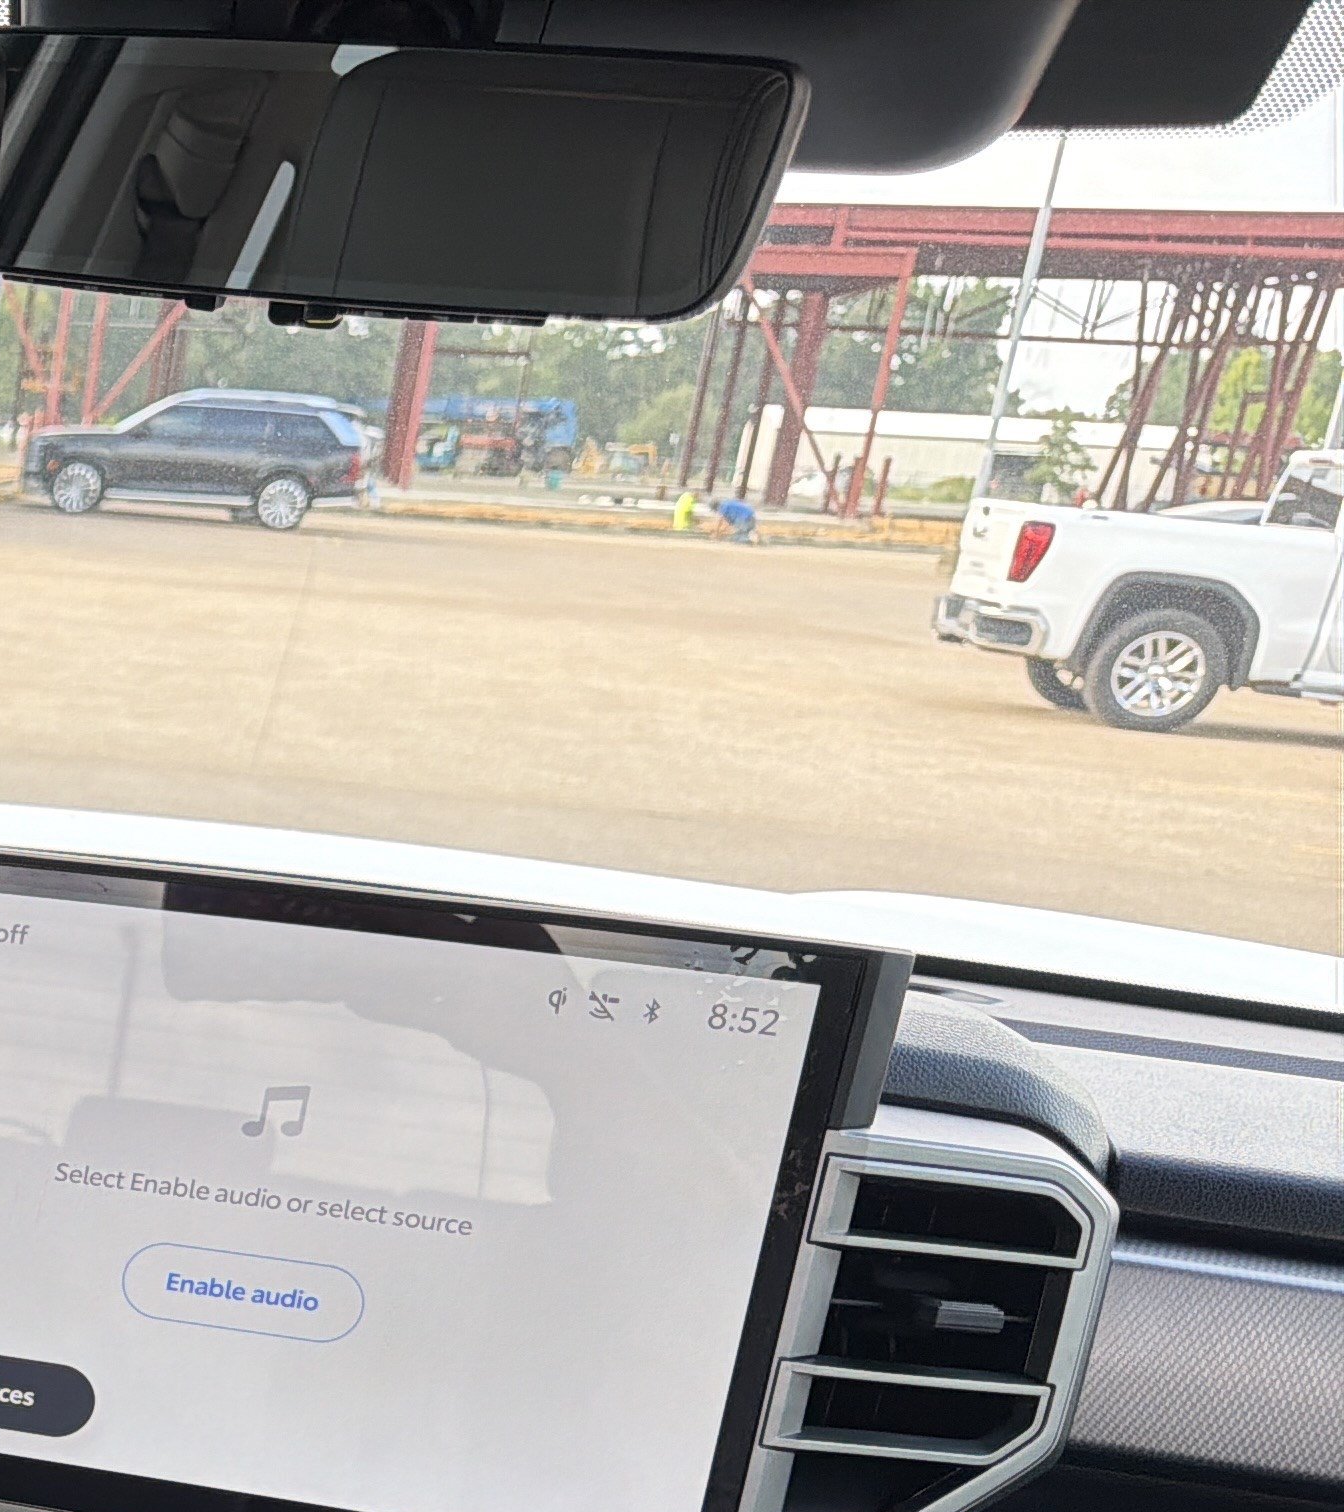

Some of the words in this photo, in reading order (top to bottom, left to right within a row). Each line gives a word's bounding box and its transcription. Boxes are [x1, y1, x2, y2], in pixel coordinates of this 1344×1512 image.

[707, 1002, 780, 1037] 8:52
[54, 1162, 125, 1190] Select
[130, 1172, 210, 1201] Enable
[214, 1185, 282, 1210] audio
[286, 1197, 313, 1215] or
[316, 1198, 388, 1225] select
[392, 1210, 474, 1236] source
[165, 1272, 246, 1301] Enable
[250, 1287, 320, 1313] audio
